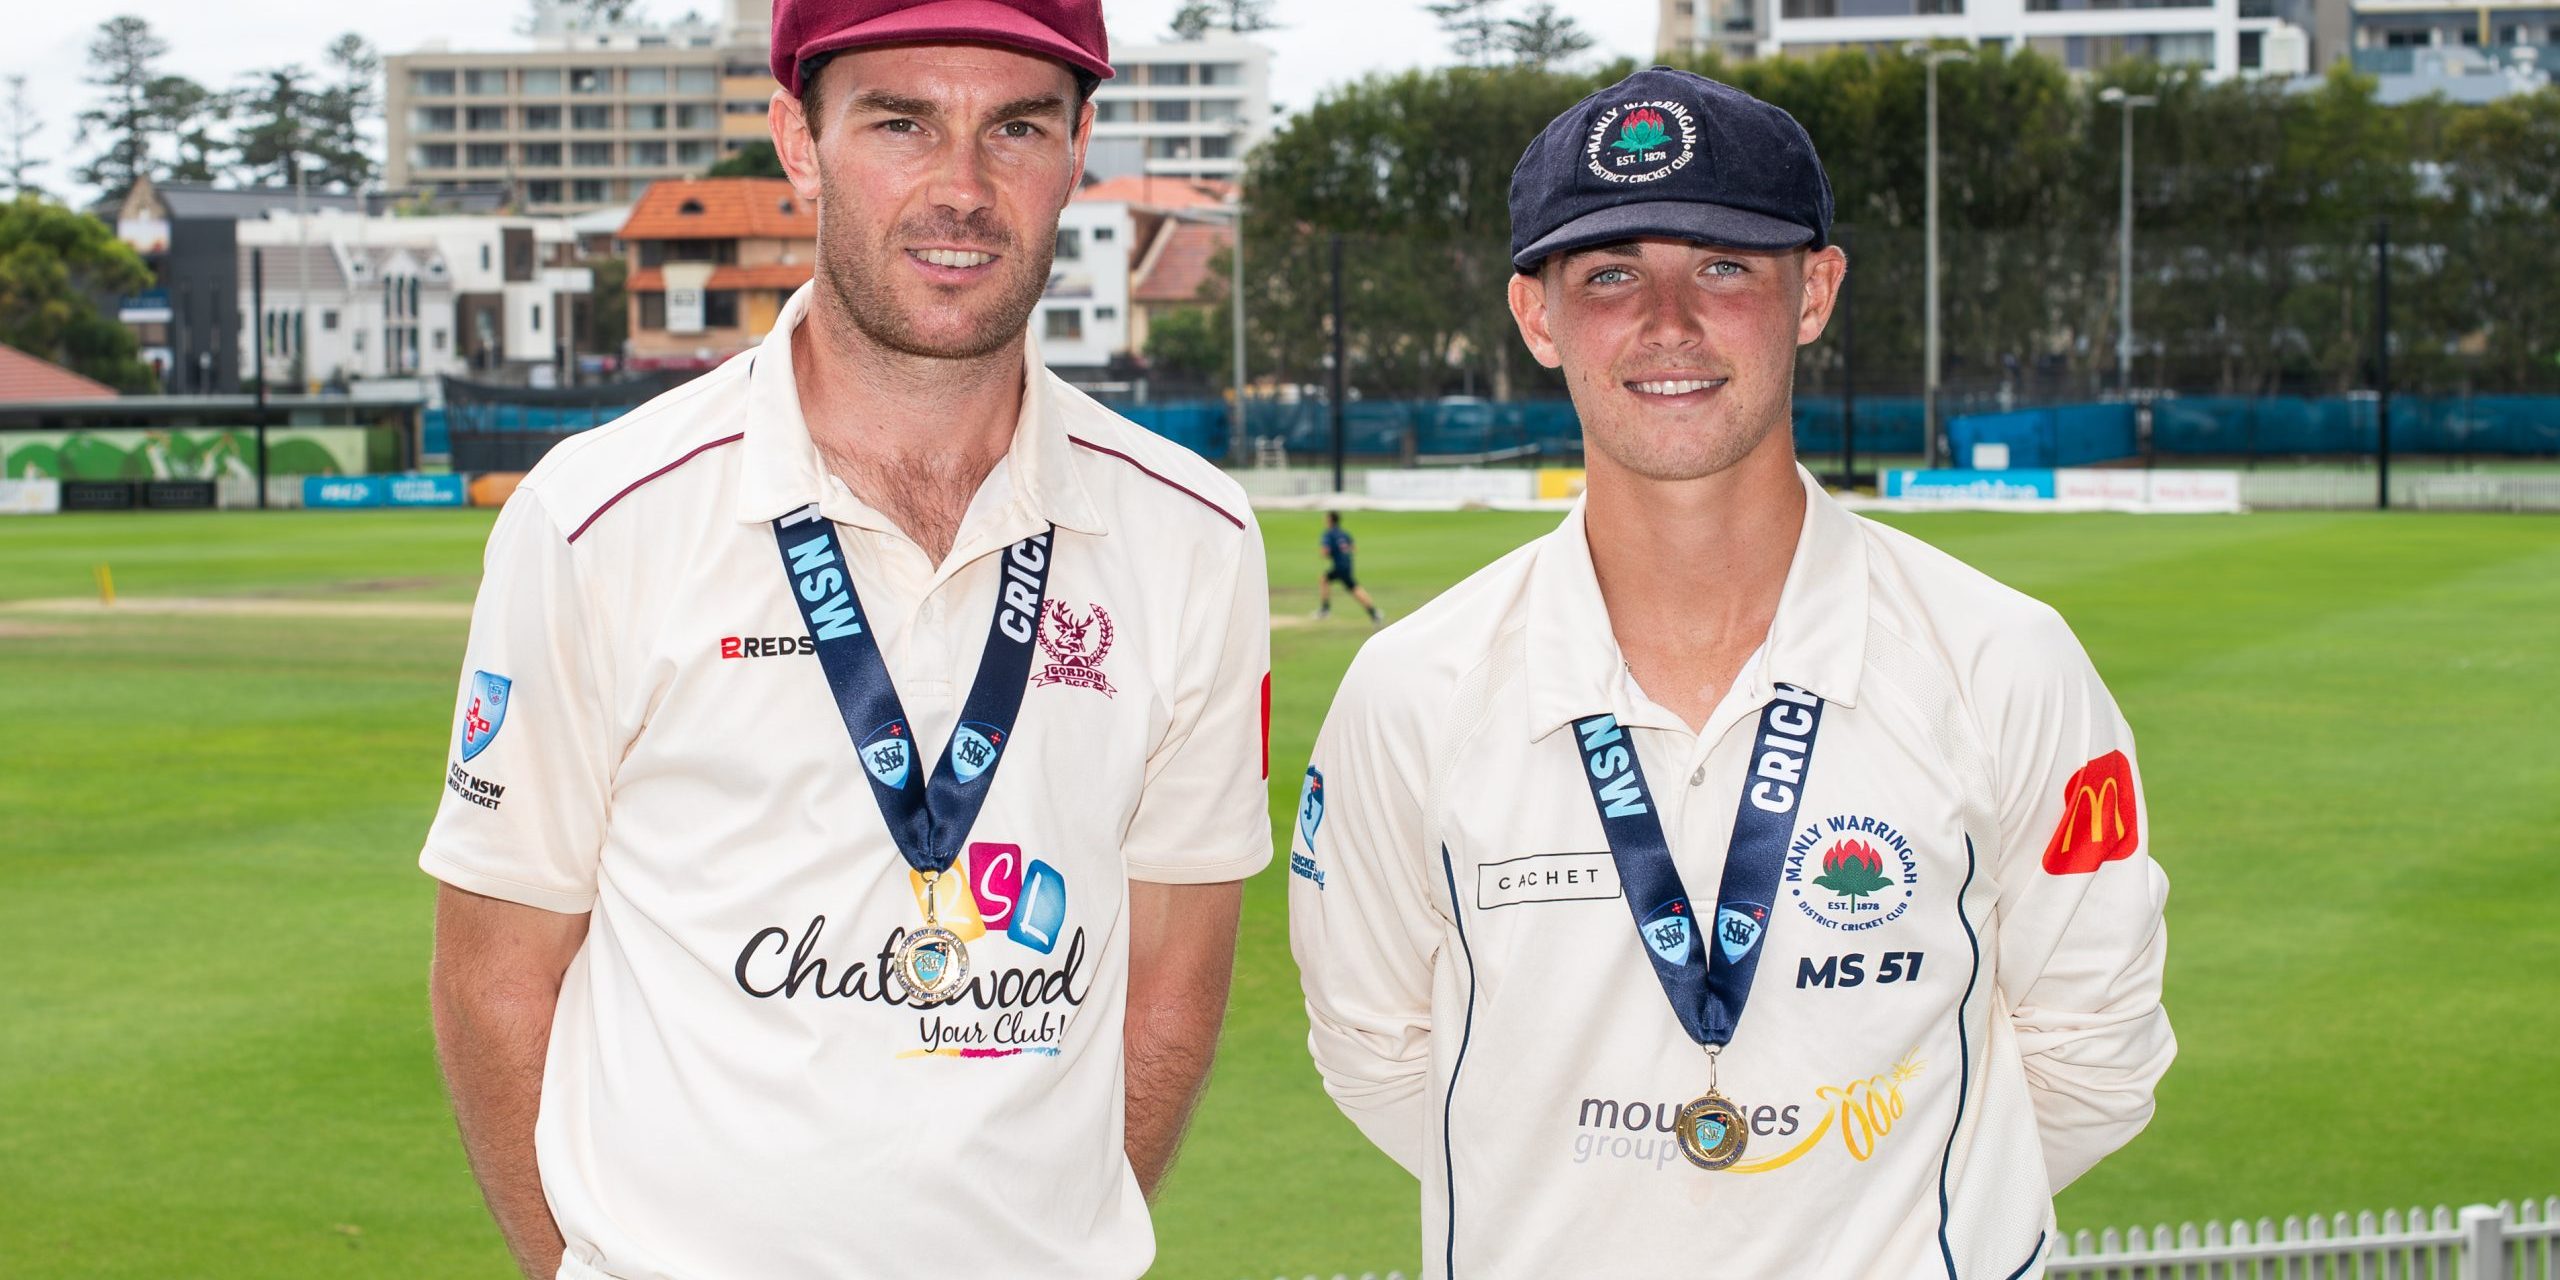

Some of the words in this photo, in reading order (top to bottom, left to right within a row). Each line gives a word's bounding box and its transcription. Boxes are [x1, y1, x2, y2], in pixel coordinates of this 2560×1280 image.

[1587, 107, 1619, 154] MANLY
[1588, 160, 1629, 183] DISTRICT
[1629, 165, 1674, 183] CRICKET
[1671, 151, 1694, 170] CLUB
[1616, 154, 1636, 167] EST.
[787, 533, 862, 642] NSW
[1050, 667, 1102, 682] GORDON
[1579, 714, 1648, 818] NSW
[460, 787, 501, 810] CRICKET
[470, 776, 506, 798] NSW
[1786, 823, 1822, 882] MANLY
[1826, 815, 1917, 884] WARRINGAH
[1499, 868, 1599, 890] CACHET
[1798, 901, 1838, 931] DISTRICT
[1841, 917, 1884, 931] CRICKET
[1886, 902, 1908, 921] CLUB
[1828, 902, 1848, 910] EST.
[1856, 902, 1880, 911] 1878
[735, 914, 1089, 1010] Chatwood
[1796, 953, 1865, 989] MS
[1876, 951, 1925, 984] 51
[919, 1015, 988, 1053] Your
[993, 1011, 1066, 1044] Club!
[1578, 1096, 1800, 1136] moues
[1573, 1132, 1679, 1170] group
